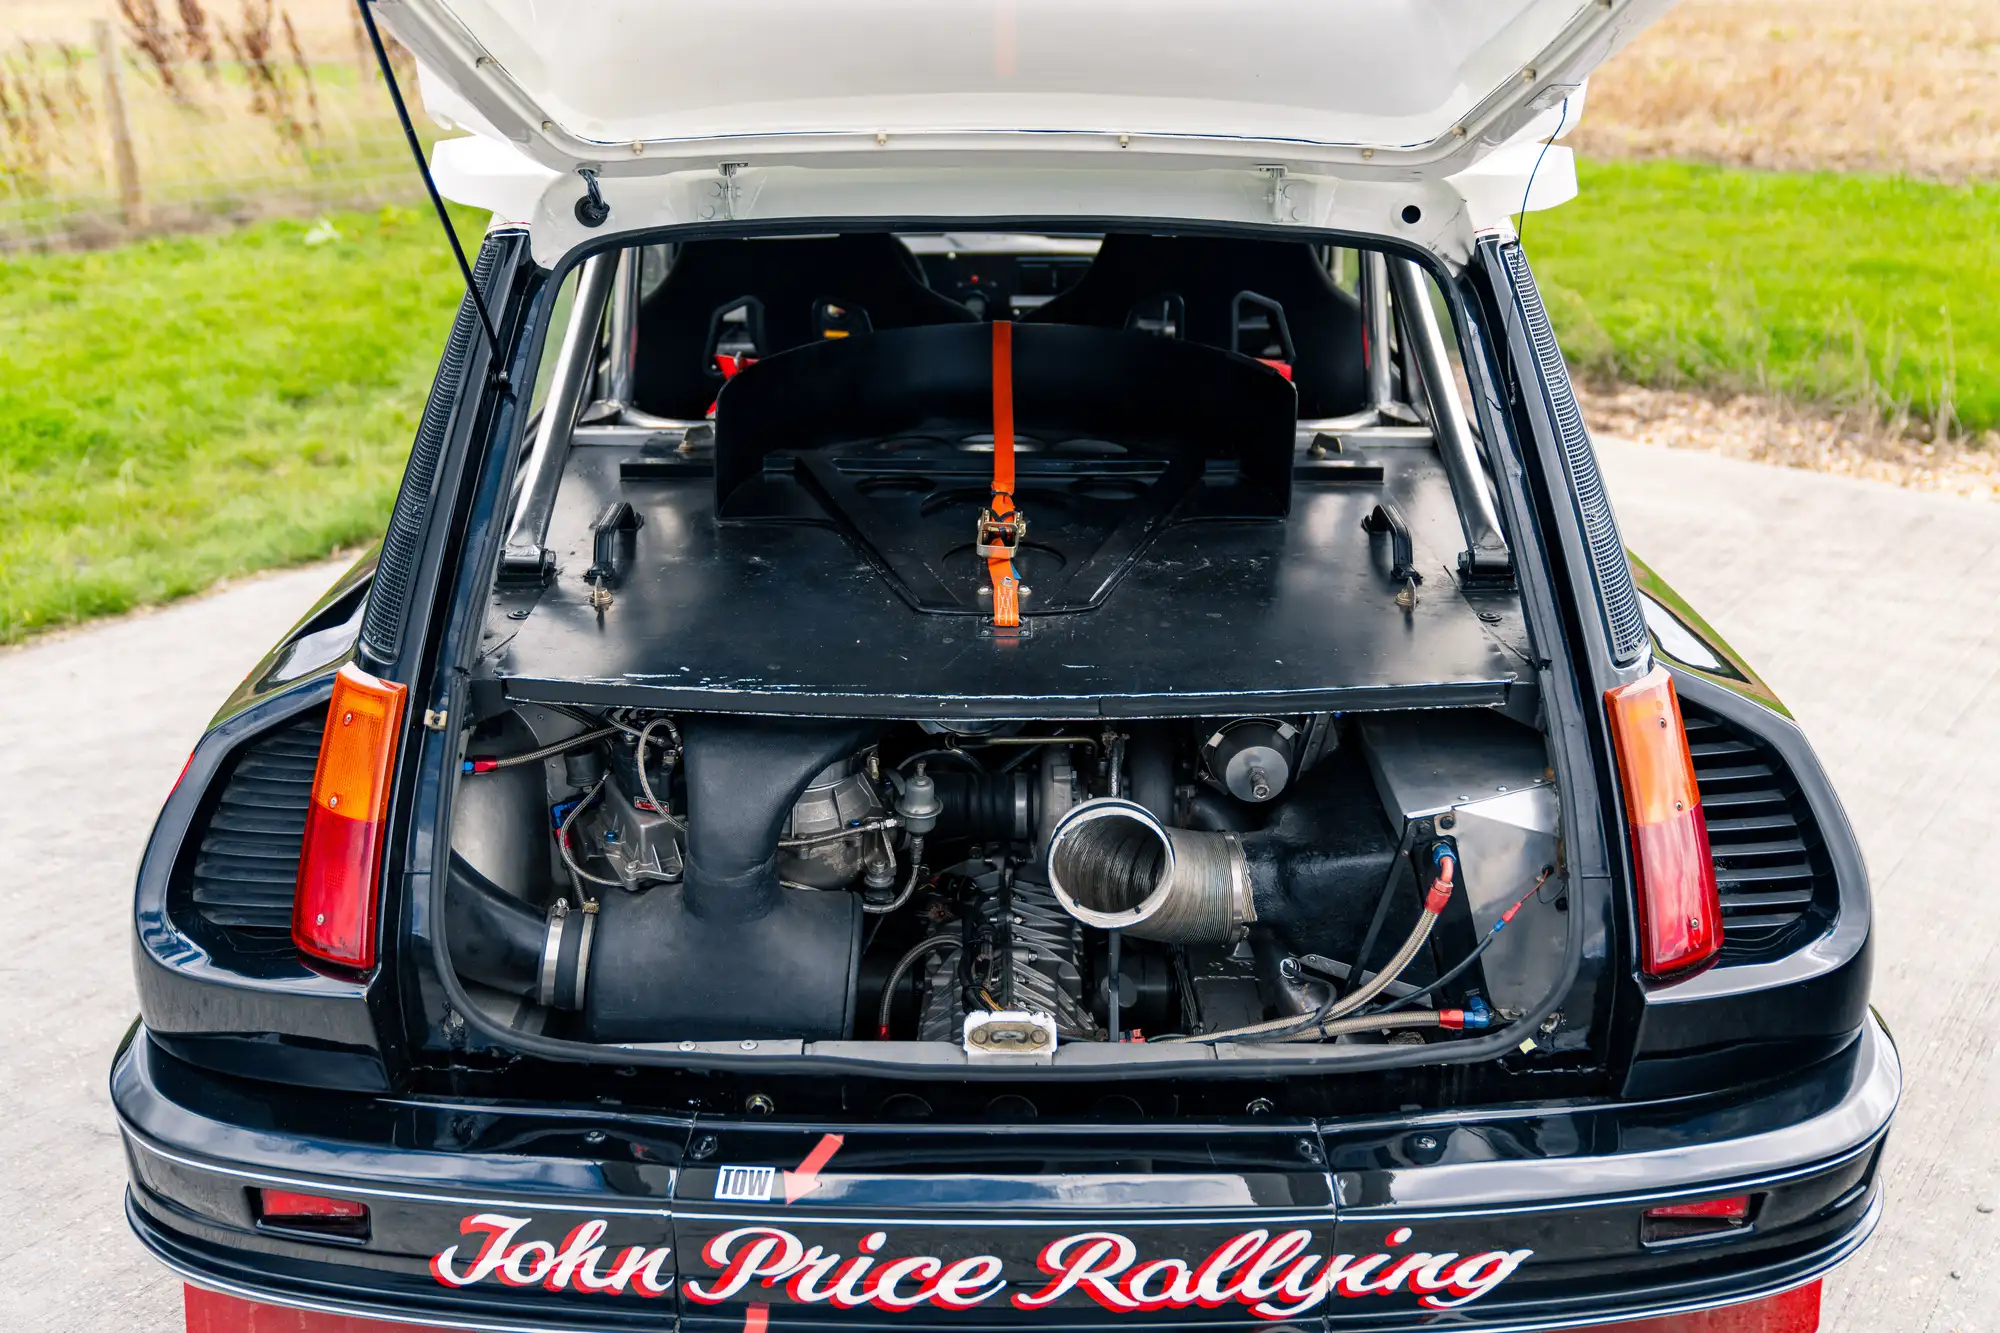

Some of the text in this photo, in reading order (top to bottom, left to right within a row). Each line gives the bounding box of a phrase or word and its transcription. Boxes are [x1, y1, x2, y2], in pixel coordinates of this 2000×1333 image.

[721, 1168, 771, 1196] TOW
[429, 1213, 1534, 1320] John Price Rallying
